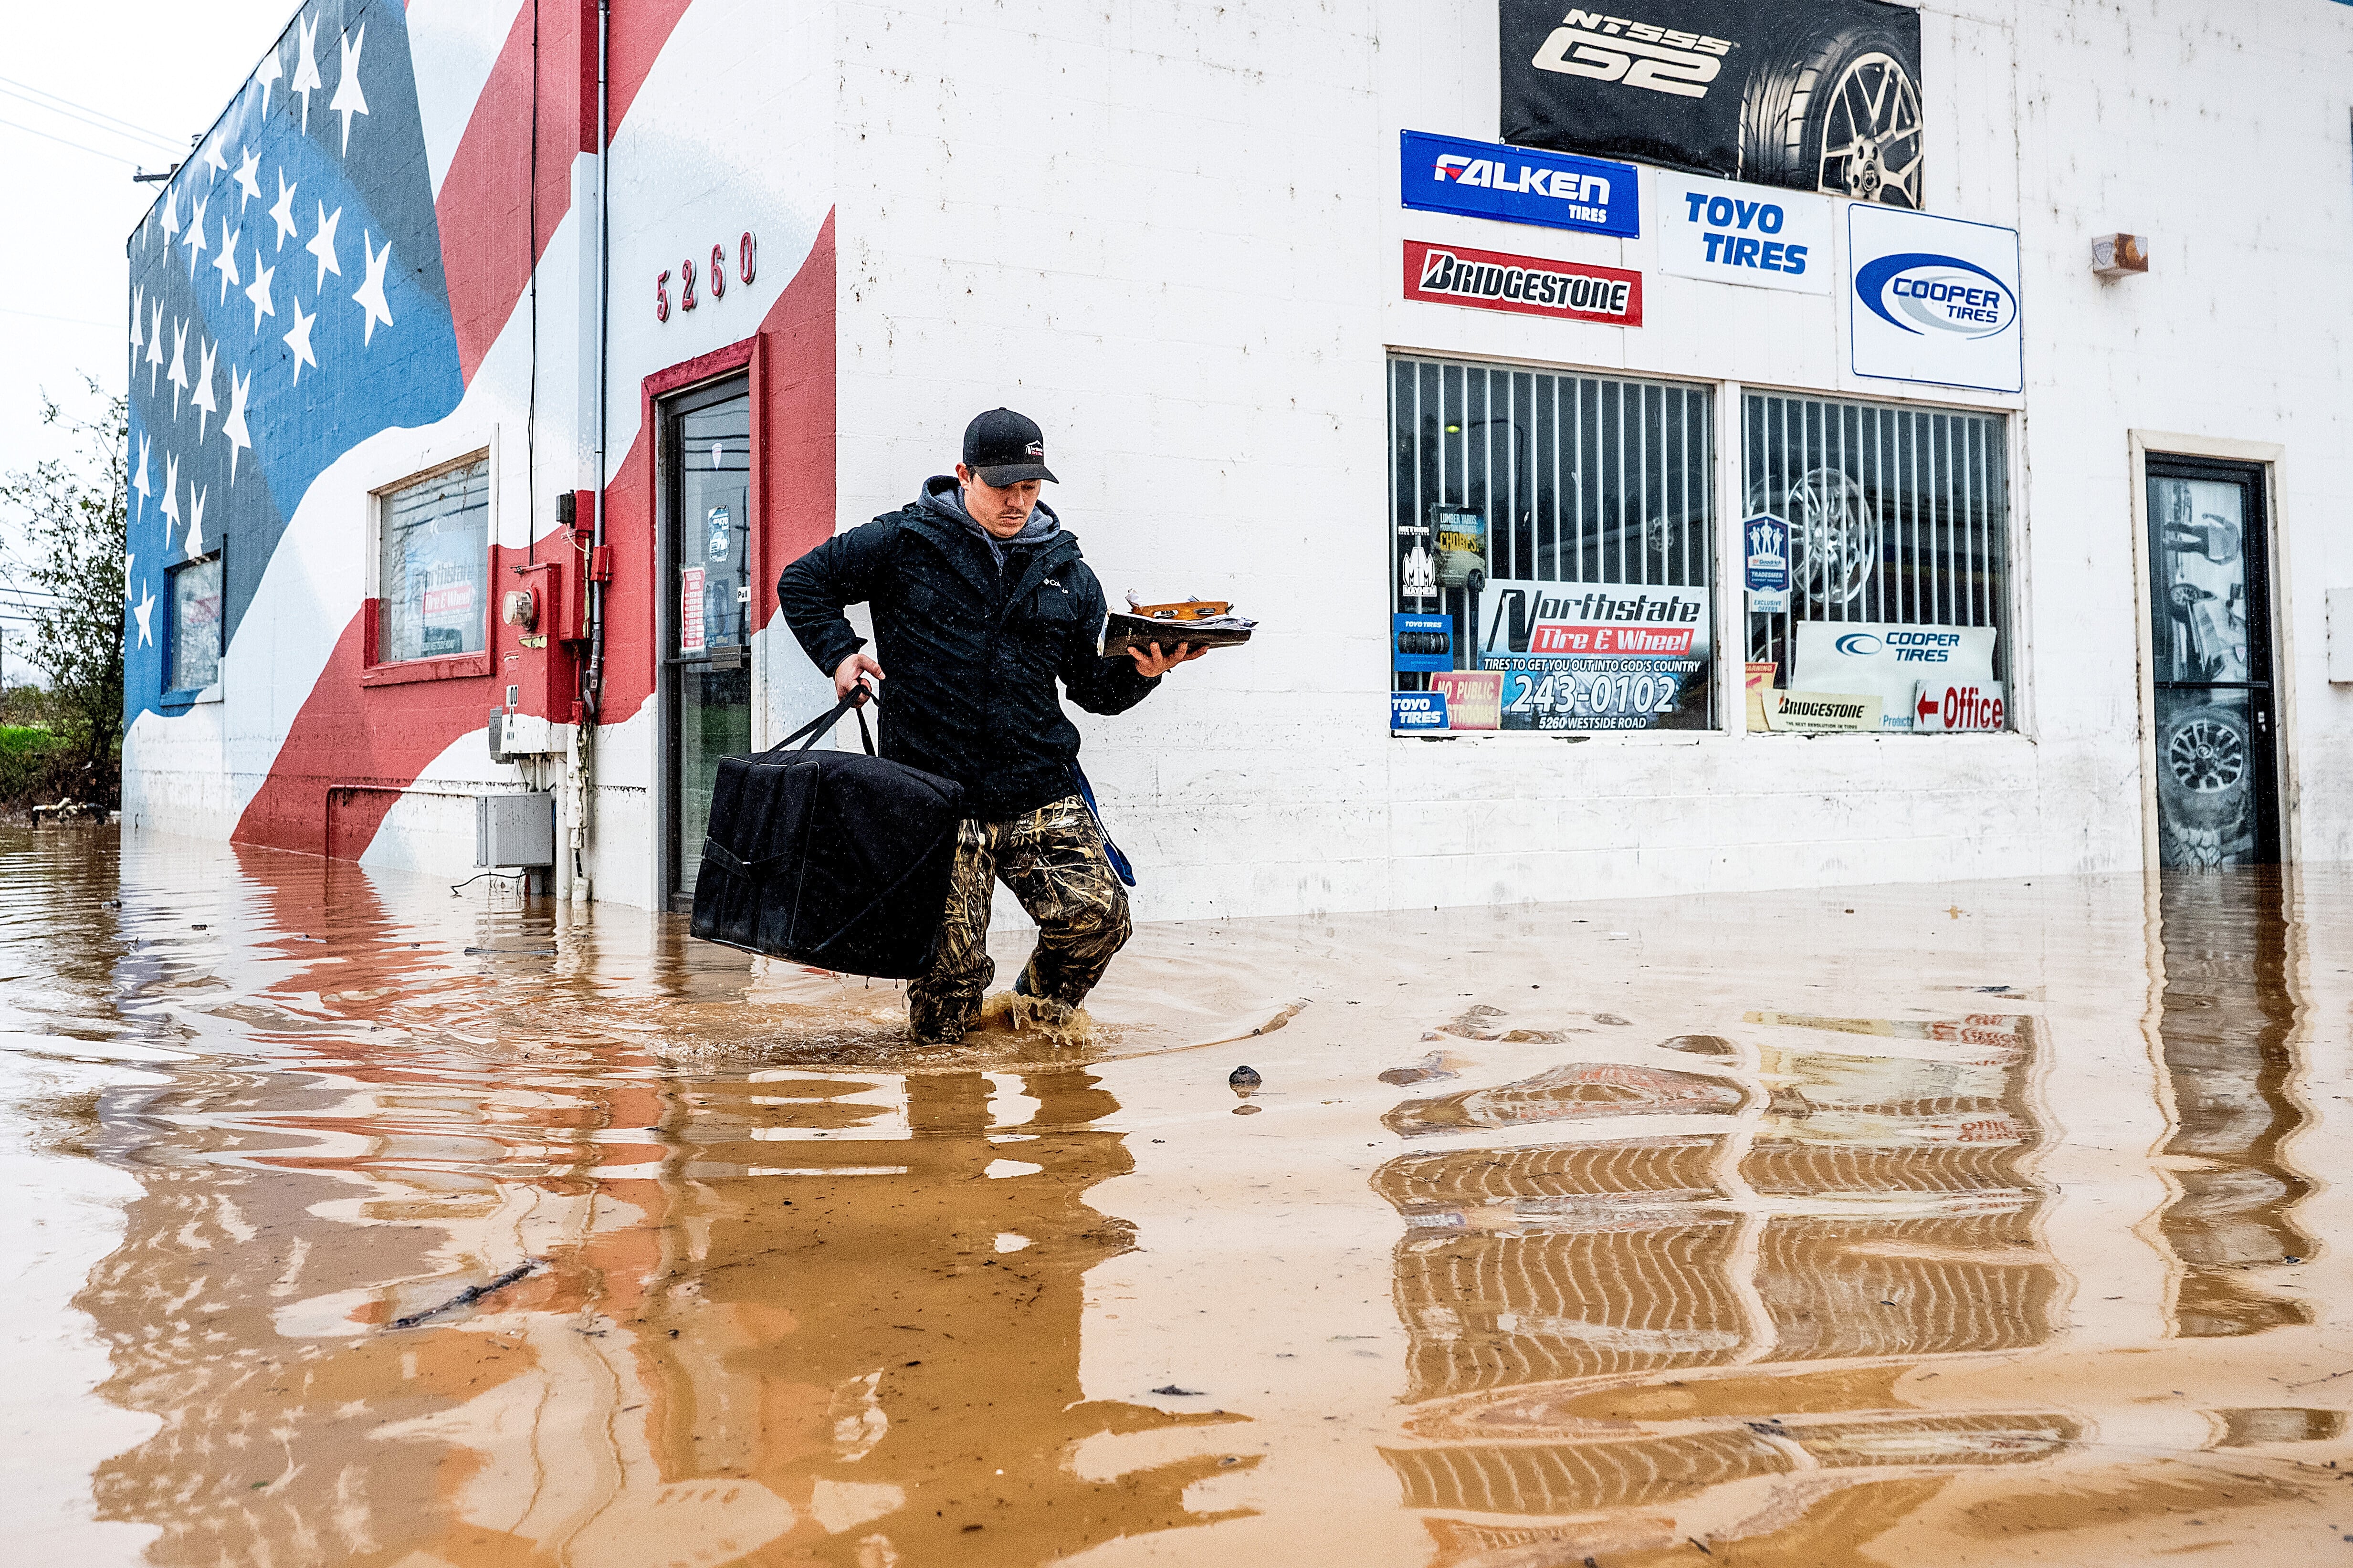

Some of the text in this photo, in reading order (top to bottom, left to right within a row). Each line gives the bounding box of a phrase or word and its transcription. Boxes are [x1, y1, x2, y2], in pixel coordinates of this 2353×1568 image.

[1562, 9, 1733, 57] NT555
[1532, 27, 1722, 99] G2
[1431, 153, 1611, 205] FALKEN
[1568, 204, 1607, 223] TIRES
[1685, 192, 1784, 234] TOYO
[1702, 233, 1808, 275] TIRES
[656, 230, 757, 322] 5260
[1422, 249, 1630, 315] BRIDGESTONE
[1892, 278, 2000, 309] COOPER
[1946, 304, 1998, 324] TIRES
[1440, 513, 1460, 524] LUMBER
[1439, 532, 1480, 553] CHORES.
[738, 590, 748, 599] Pull
[1404, 586, 1436, 595] MAYHEM
[1487, 588, 1701, 652] Northstate
[1539, 628, 1588, 649] Tire
[1617, 629, 1690, 651] Wheel
[1886, 632, 1960, 647] COOPER
[1484, 659, 1701, 672] TIRES TO GET YOU OUT INTO GOD'S COUNTRY
[1895, 648, 1949, 662] TIRES
[1437, 680, 1494, 700] NO PUBLIC
[1510, 674, 1676, 713] 243-0102
[1392, 698, 1430, 711] TOYO
[1778, 698, 1865, 719] BRIDGESTONE
[1943, 686, 2004, 729] Office
[1399, 711, 1441, 724] TIRES
[1538, 717, 1647, 729] 5260 WESTSIDE ROAD
